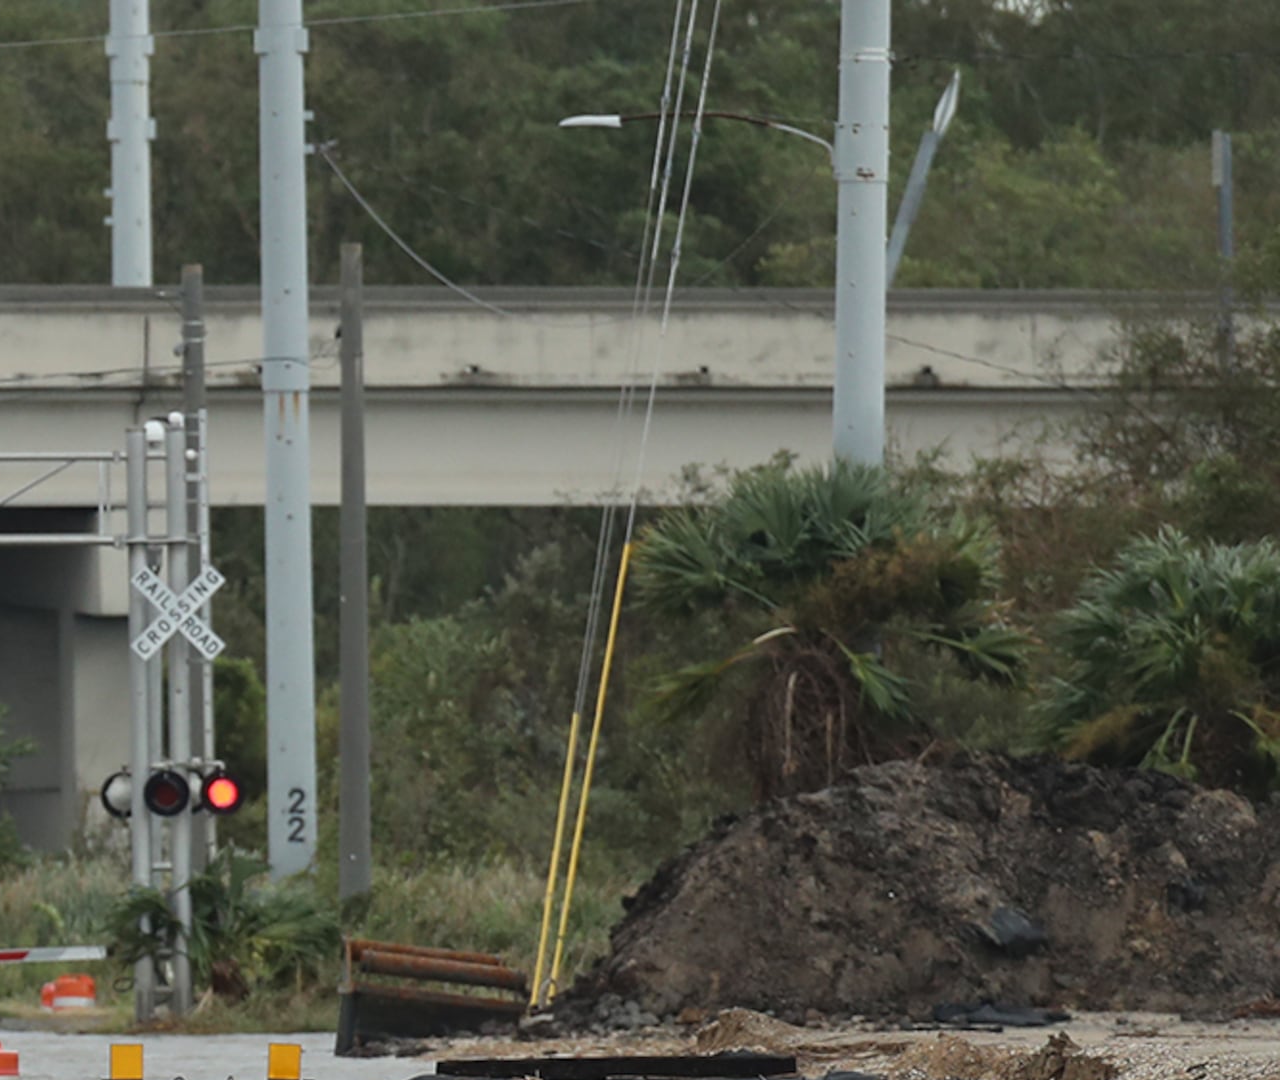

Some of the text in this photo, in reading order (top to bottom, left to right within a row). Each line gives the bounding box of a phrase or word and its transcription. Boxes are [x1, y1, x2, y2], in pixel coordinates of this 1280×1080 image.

[135, 570, 220, 655] RAIL ROAD
[137, 570, 219, 654] CROSSING
